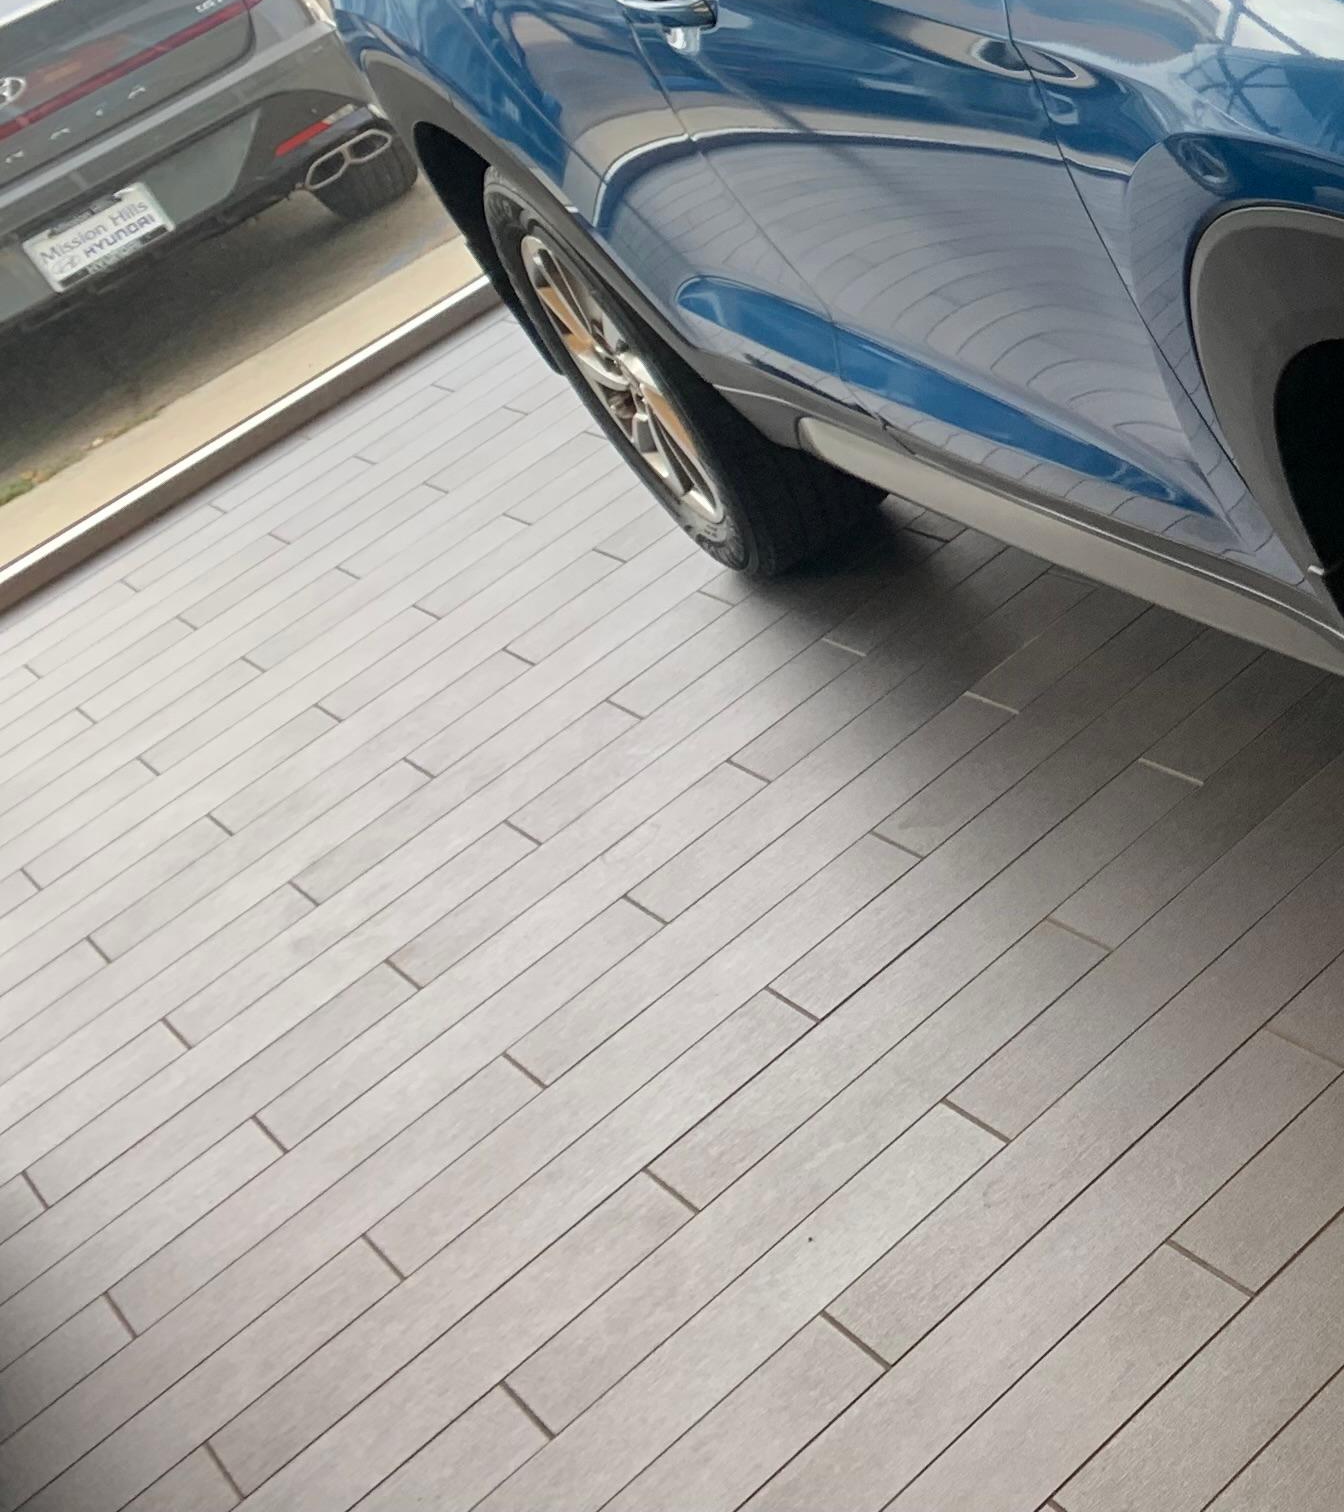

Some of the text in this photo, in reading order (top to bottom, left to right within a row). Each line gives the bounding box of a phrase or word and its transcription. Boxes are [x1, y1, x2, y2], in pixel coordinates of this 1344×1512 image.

[39, 223, 107, 265] Mission
[110, 201, 149, 227] Hills
[84, 213, 156, 259] HYUNDAI
